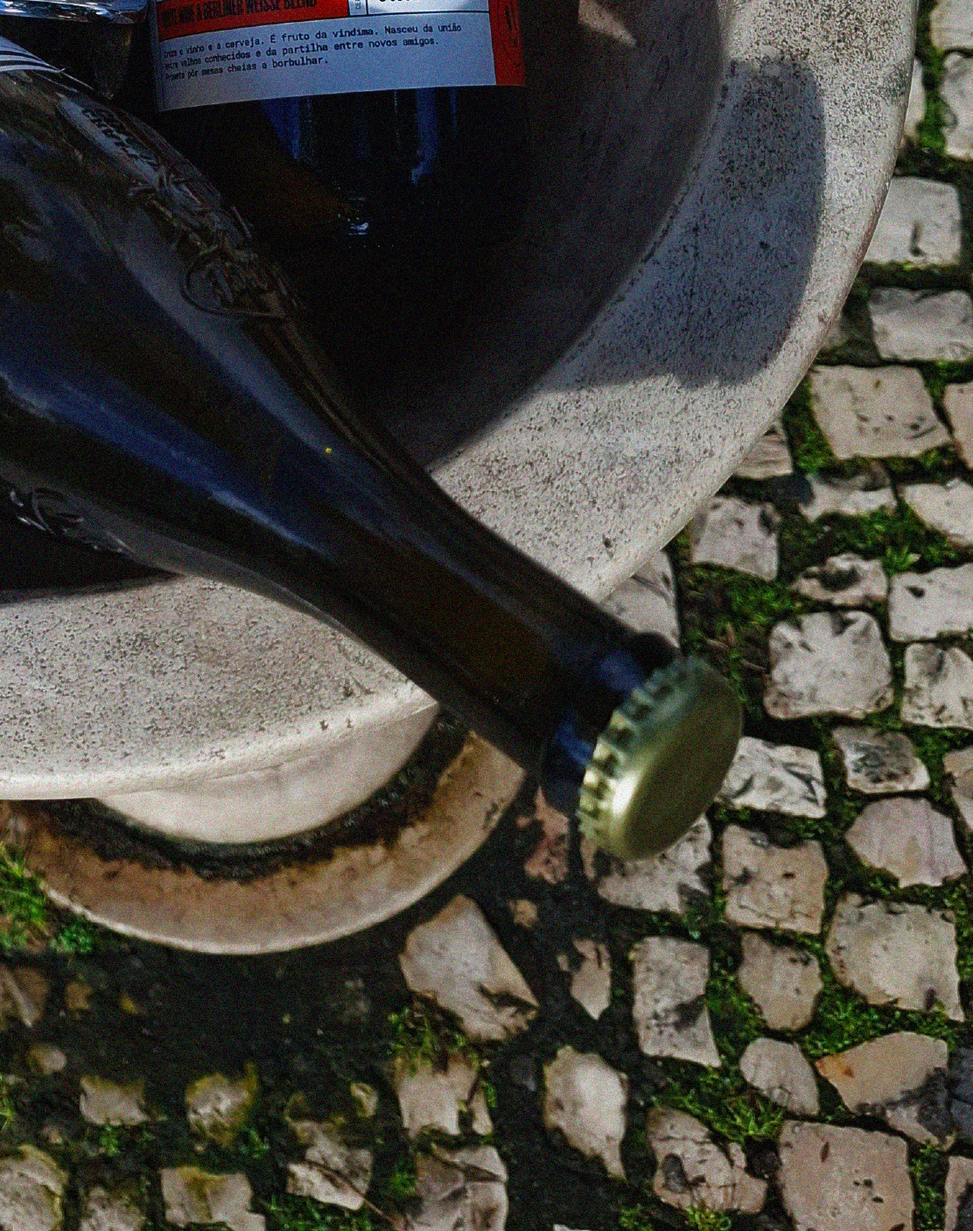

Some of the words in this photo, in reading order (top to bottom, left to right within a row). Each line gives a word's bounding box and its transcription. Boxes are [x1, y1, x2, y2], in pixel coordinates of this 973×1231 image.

[186, 43, 205, 54] vinho
[225, 38, 265, 50] cerveja.
[270, 34, 277, 44] É
[281, 32, 310, 42] fruto
[315, 30, 327, 40] da
[332, 26, 379, 39] vindima.
[384, 24, 418, 35] Nasceu
[422, 24, 434, 33] da
[437, 23, 462, 32] união
[204, 50, 251, 64] conhecidos
[255, 50, 262, 58] e
[265, 46, 277, 57] da
[282, 42, 329, 56] partilha
[333, 41, 364, 51] entre
[368, 37, 398, 48] novos
[402, 37, 440, 49] amigos.
[227, 61, 257, 74] cheias
[261, 61, 268, 69] a
[272, 55, 329, 69] borbulhar.
